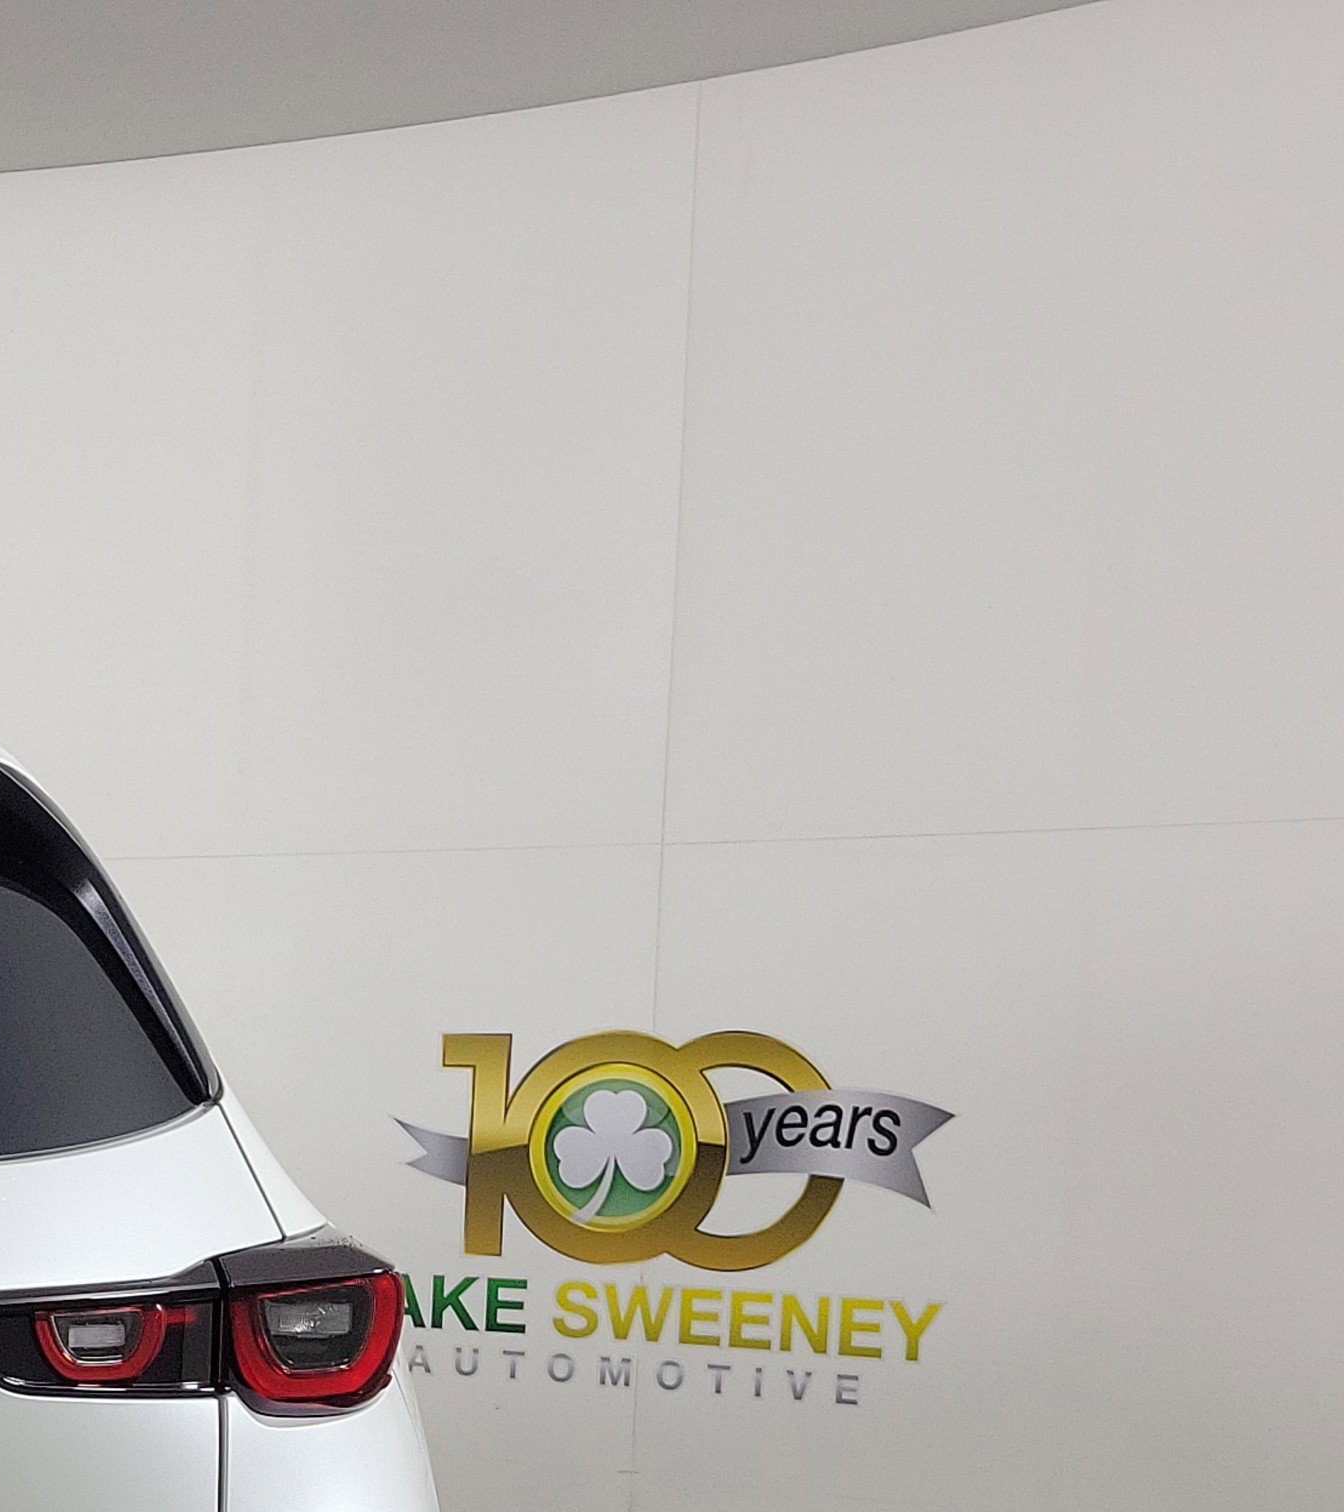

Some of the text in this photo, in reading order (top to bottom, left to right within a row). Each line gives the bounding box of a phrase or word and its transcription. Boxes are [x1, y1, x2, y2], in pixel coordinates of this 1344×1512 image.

[442, 1030, 845, 1273] 100
[739, 1103, 902, 1165] years
[552, 1280, 942, 1362] SWEENEY
[408, 1344, 860, 1406] AUTOMOTIVE
